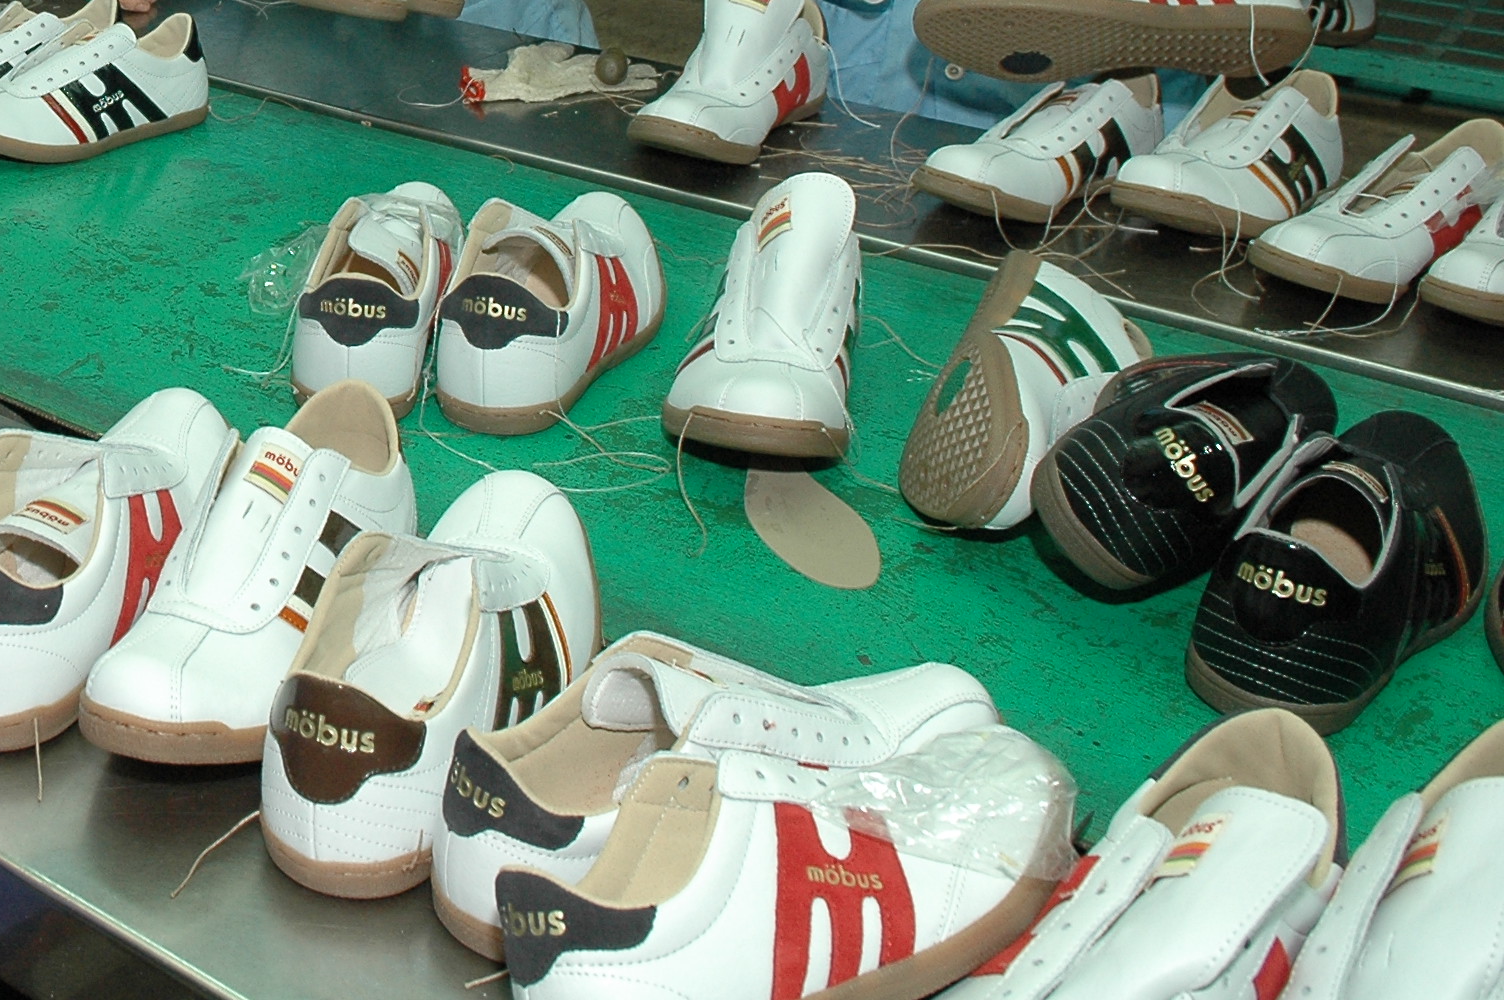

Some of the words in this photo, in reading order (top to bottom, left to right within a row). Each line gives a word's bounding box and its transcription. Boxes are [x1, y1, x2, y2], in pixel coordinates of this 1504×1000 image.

[92, 90, 125, 113] möbus
[320, 296, 387, 319] möbus
[461, 296, 528, 322] möbus
[264, 450, 300, 477] möbu
[1152, 425, 1215, 503] möbus
[1236, 560, 1328, 607] möbus
[512, 668, 544, 691] möbus
[284, 704, 376, 754] möbus
[450, 756, 506, 818] öbus
[806, 863, 884, 890] möbus
